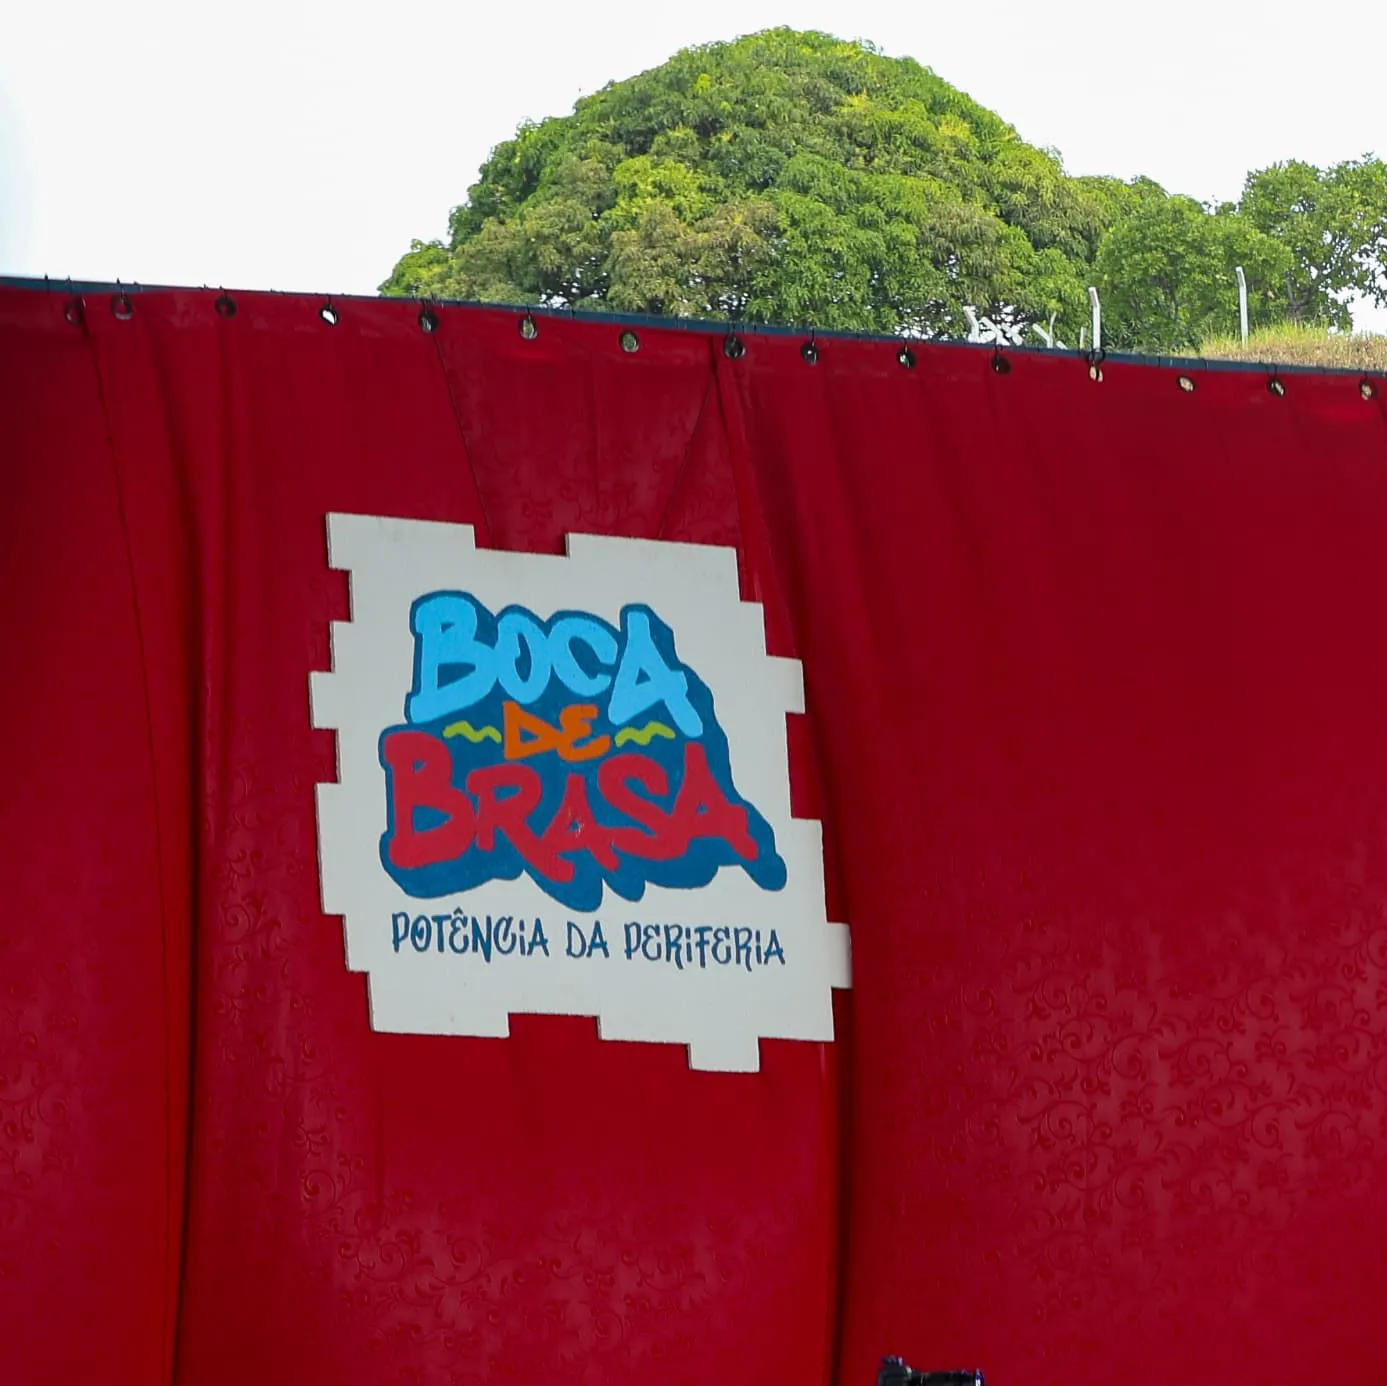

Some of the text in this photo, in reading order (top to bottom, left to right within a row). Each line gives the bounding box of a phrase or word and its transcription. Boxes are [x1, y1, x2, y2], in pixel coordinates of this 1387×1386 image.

[410, 595, 703, 738] BOCA
[503, 702, 611, 763] DE
[383, 730, 759, 883] BRASA
[566, 919, 610, 959] DA
